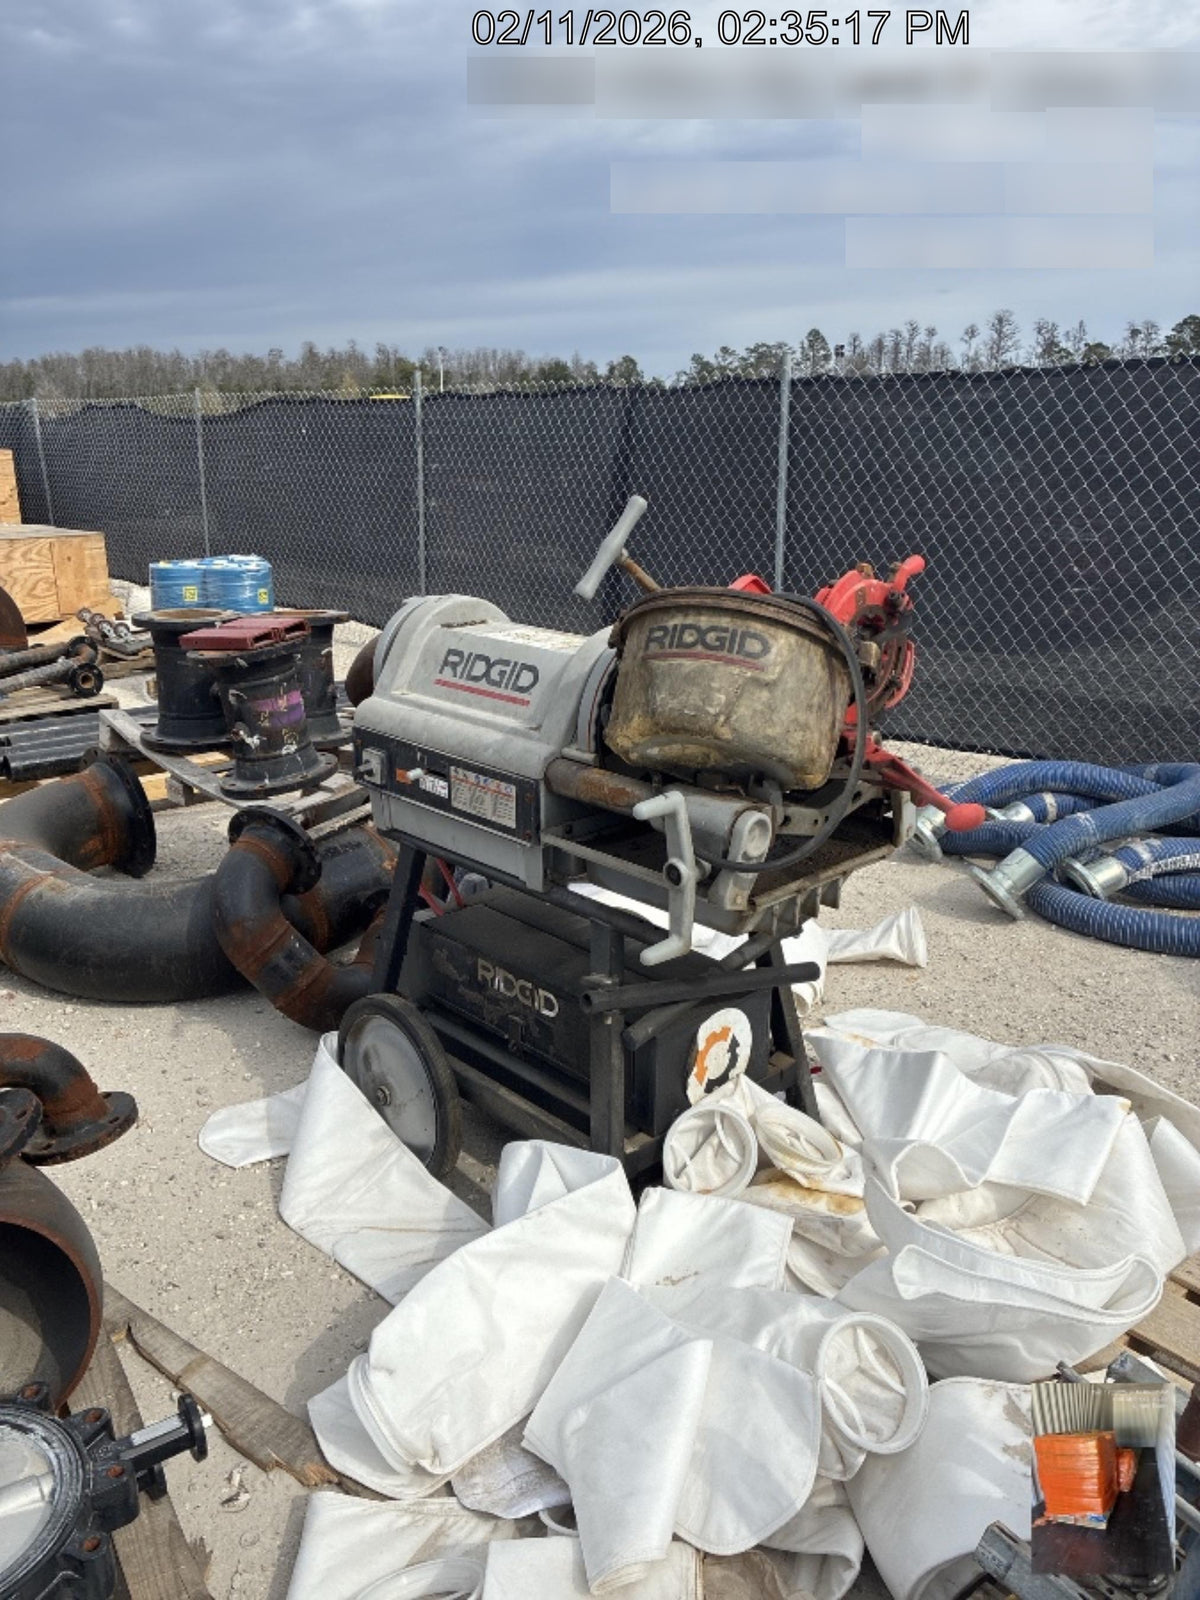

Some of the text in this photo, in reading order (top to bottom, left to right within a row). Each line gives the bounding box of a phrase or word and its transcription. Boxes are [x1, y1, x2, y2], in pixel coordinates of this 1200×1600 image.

[644, 623, 772, 660] RIDGID
[438, 648, 540, 694] RIDGID
[477, 957, 560, 1018] RIDGID
